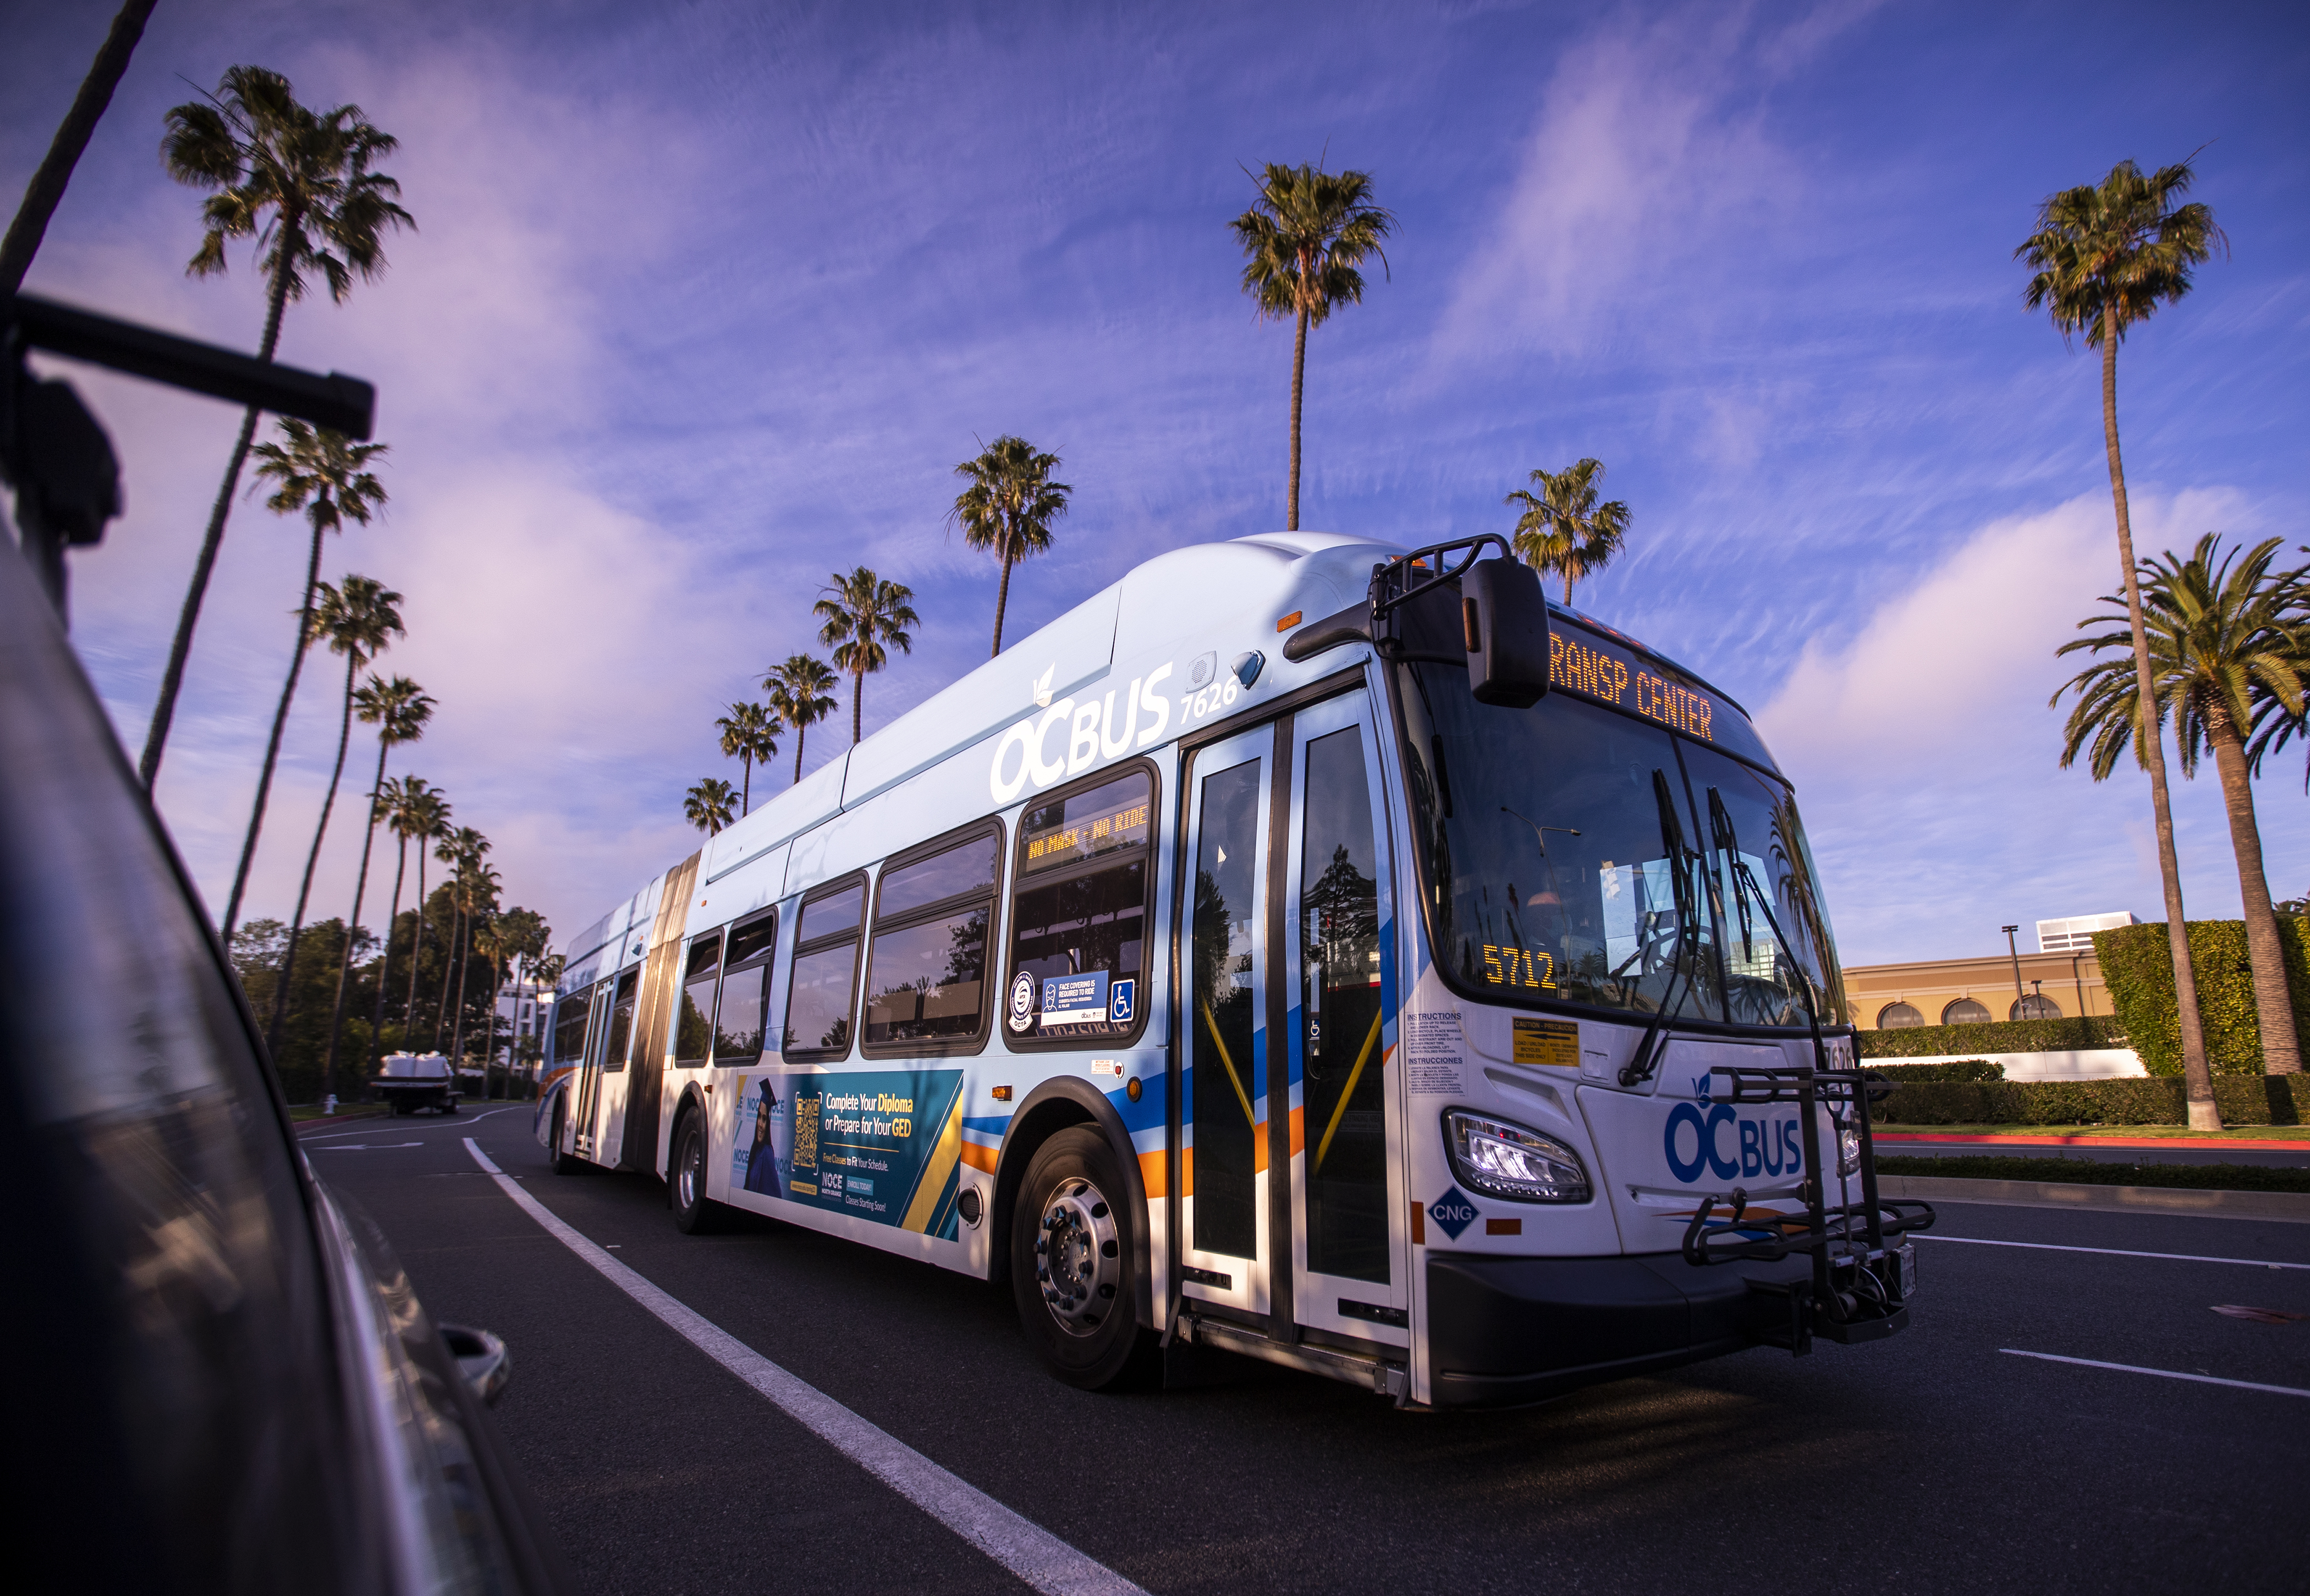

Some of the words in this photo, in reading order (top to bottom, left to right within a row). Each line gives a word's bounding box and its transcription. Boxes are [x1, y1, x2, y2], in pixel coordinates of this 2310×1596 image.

[1549, 631, 1628, 704] RANSP
[1637, 671, 1712, 741] CENTER
[1180, 675, 1238, 725] 7626
[1028, 840, 1043, 859] NO
[1048, 829, 1079, 853] MASK
[1093, 818, 1110, 839] NO
[1115, 805, 1147, 832] RIDE
[1483, 944, 1556, 989] 5712
[1014, 975, 1022, 988] HEALTH
[1070, 981, 1091, 989] COVERING
[1059, 989, 1078, 998] REQUIRED
[747, 1097, 761, 1111] NOC
[826, 1092, 859, 1113] Complete
[860, 1093, 877, 1111] Your
[878, 1093, 913, 1115] Diploma
[825, 1119, 832, 1130] or
[833, 1115, 860, 1136] Prepare
[861, 1116, 873, 1134] for
[873, 1117, 891, 1136] Your
[892, 1118, 911, 1137] GED
[734, 1148, 749, 1163] NOCE
[823, 1153, 832, 1163] Free
[832, 1154, 846, 1165] Classes
[847, 1157, 851, 1165] to
[858, 1158, 867, 1168] Your
[868, 1159, 888, 1171] Schedule.
[822, 1171, 843, 1190] NOCE
[848, 1180, 859, 1189] ENROLL
[860, 1182, 872, 1191] TODAY!
[846, 1195, 859, 1206] Classes
[859, 1198, 874, 1211] Starting
[875, 1201, 886, 1212] Soon!
[1433, 1205, 1472, 1220] CNG
